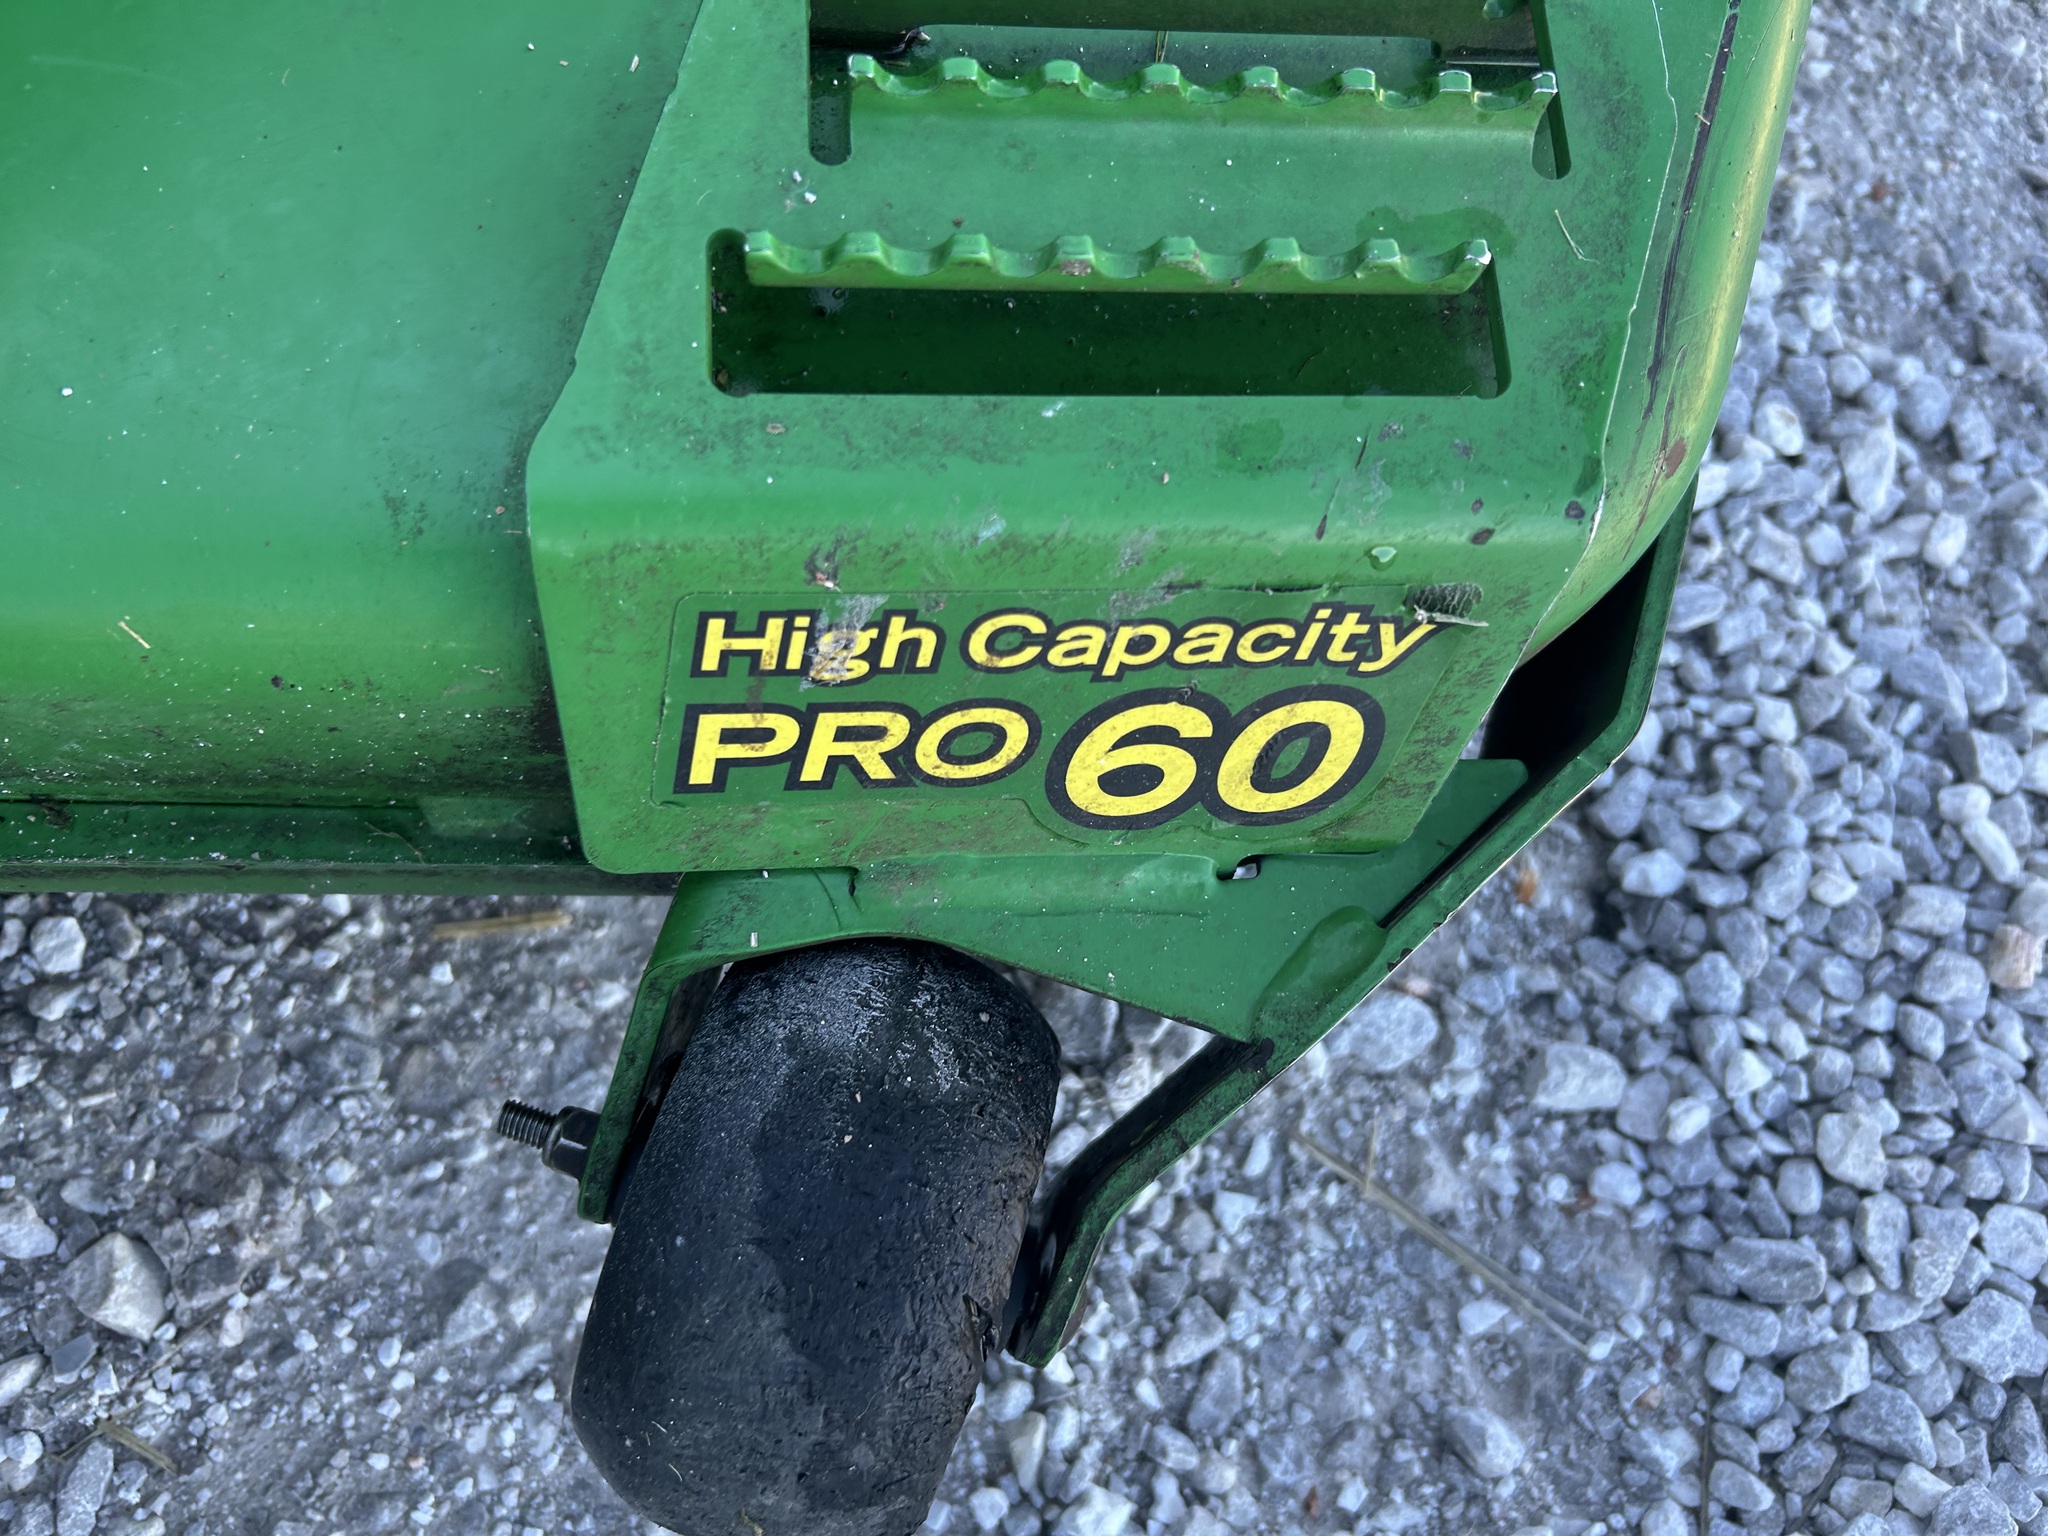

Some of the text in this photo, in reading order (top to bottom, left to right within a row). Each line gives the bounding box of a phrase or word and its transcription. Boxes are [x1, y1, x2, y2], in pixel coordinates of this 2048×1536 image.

[692, 604, 1437, 683] High Capacity
[679, 691, 1375, 824] PRO 60
